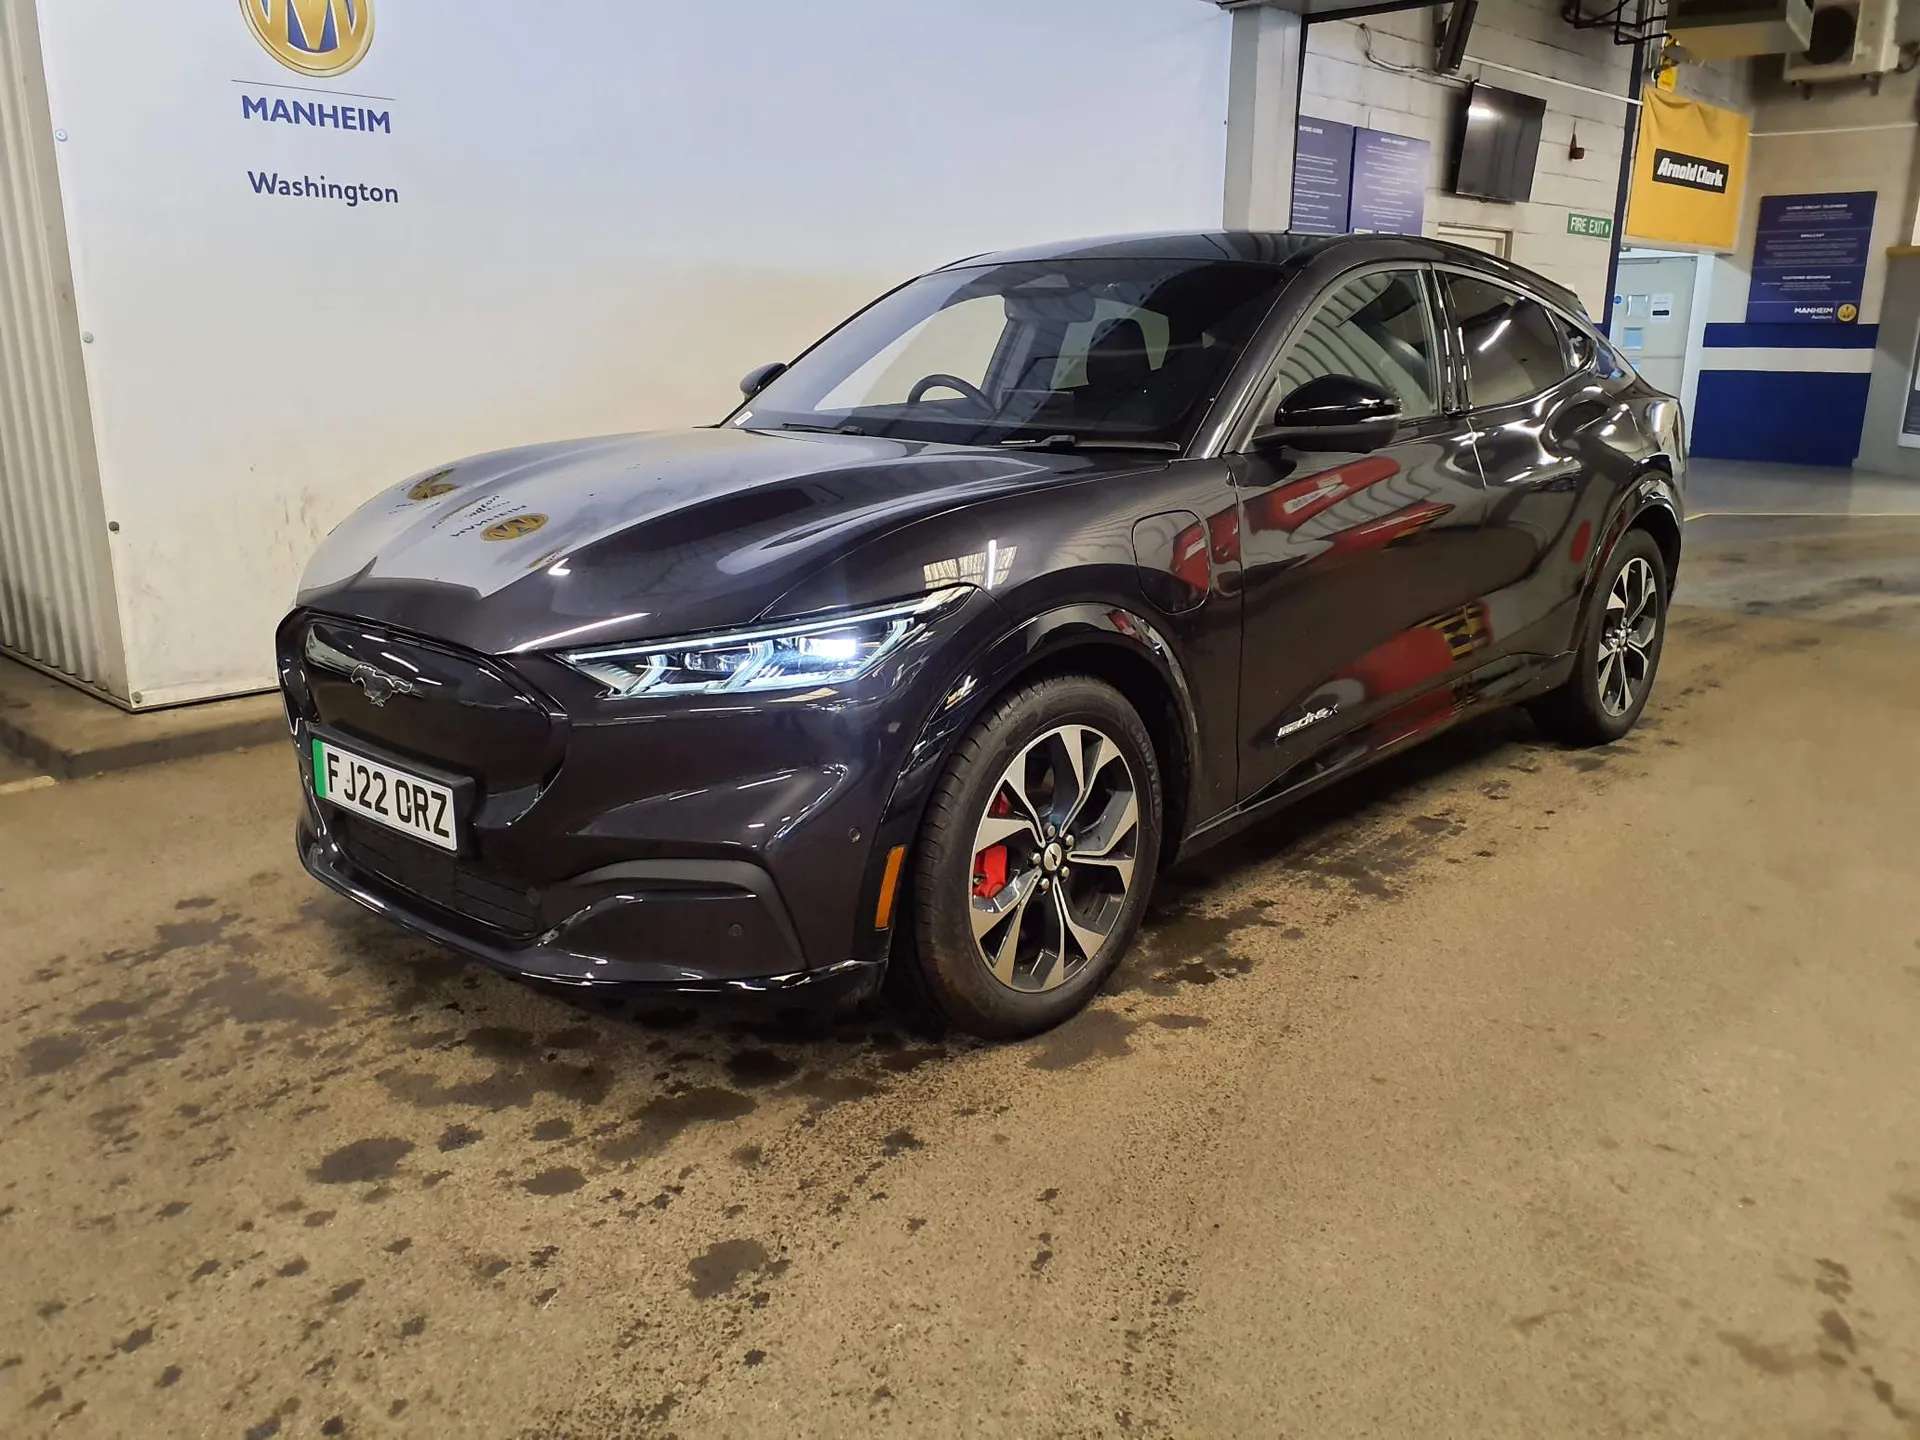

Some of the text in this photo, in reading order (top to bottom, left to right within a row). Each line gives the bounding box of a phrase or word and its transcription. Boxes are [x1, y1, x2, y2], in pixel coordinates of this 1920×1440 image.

[241, 95, 391, 134] MANHEIM
[247, 170, 399, 207] Washington
[1657, 157, 1724, 187] Arnold Clark
[1570, 216, 1605, 235] FIRE EXIT
[326, 752, 450, 838] FJ22 ORZ
